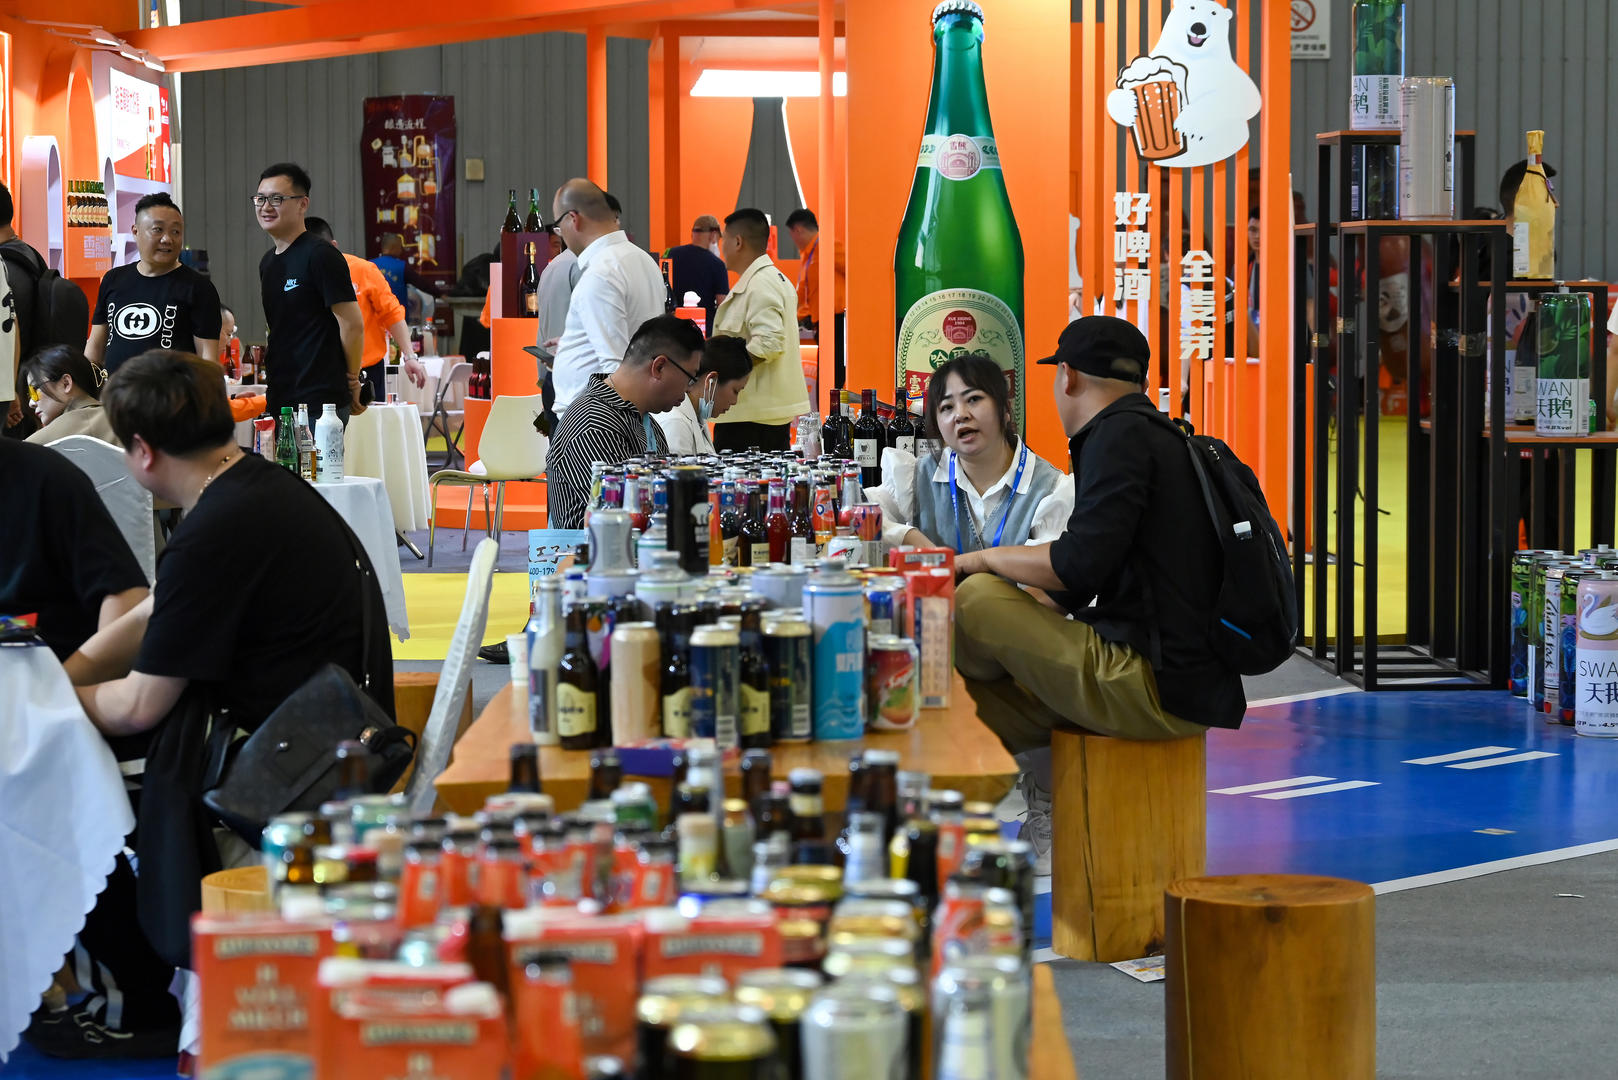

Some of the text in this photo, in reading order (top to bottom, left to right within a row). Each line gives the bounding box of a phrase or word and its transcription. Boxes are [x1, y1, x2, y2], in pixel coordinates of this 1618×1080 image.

[1113, 192, 1152, 301] 好啤酒
[160, 304, 178, 349] GUCCI
[1179, 250, 1217, 360] 全麦芽
[1536, 396, 1573, 419] 天鹅
